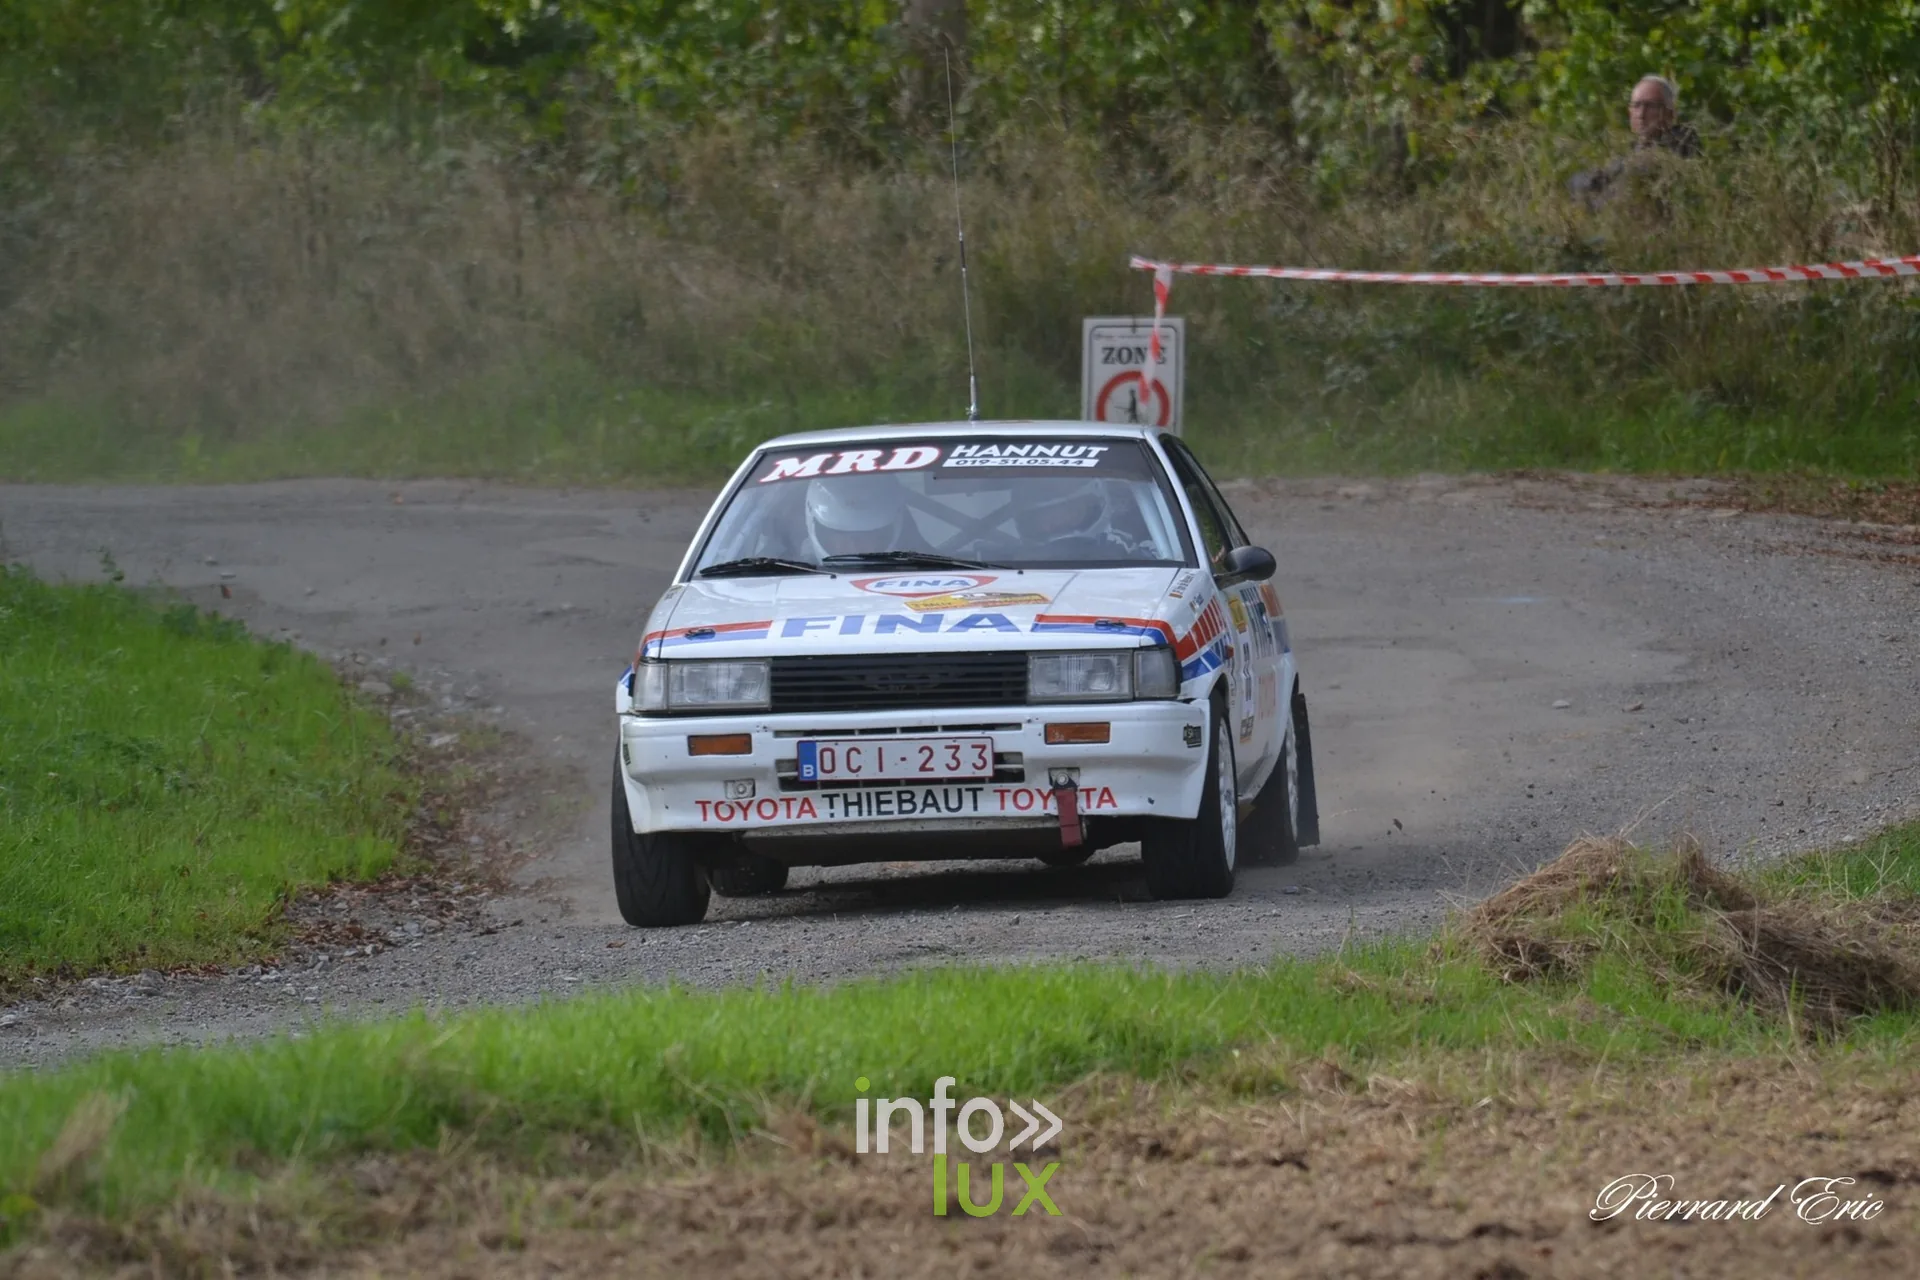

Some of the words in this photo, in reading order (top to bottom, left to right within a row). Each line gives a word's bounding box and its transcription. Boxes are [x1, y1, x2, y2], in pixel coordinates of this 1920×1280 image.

[950, 444, 1109, 459] HANNUT
[759, 447, 940, 483] MRD
[874, 579, 971, 589] FINA
[780, 613, 1022, 637] FINA
[803, 764, 814, 777] B
[695, 796, 818, 822] TOYOTA
[821, 787, 984, 819] THIEBAUT
[993, 786, 1118, 811] TOYTA
